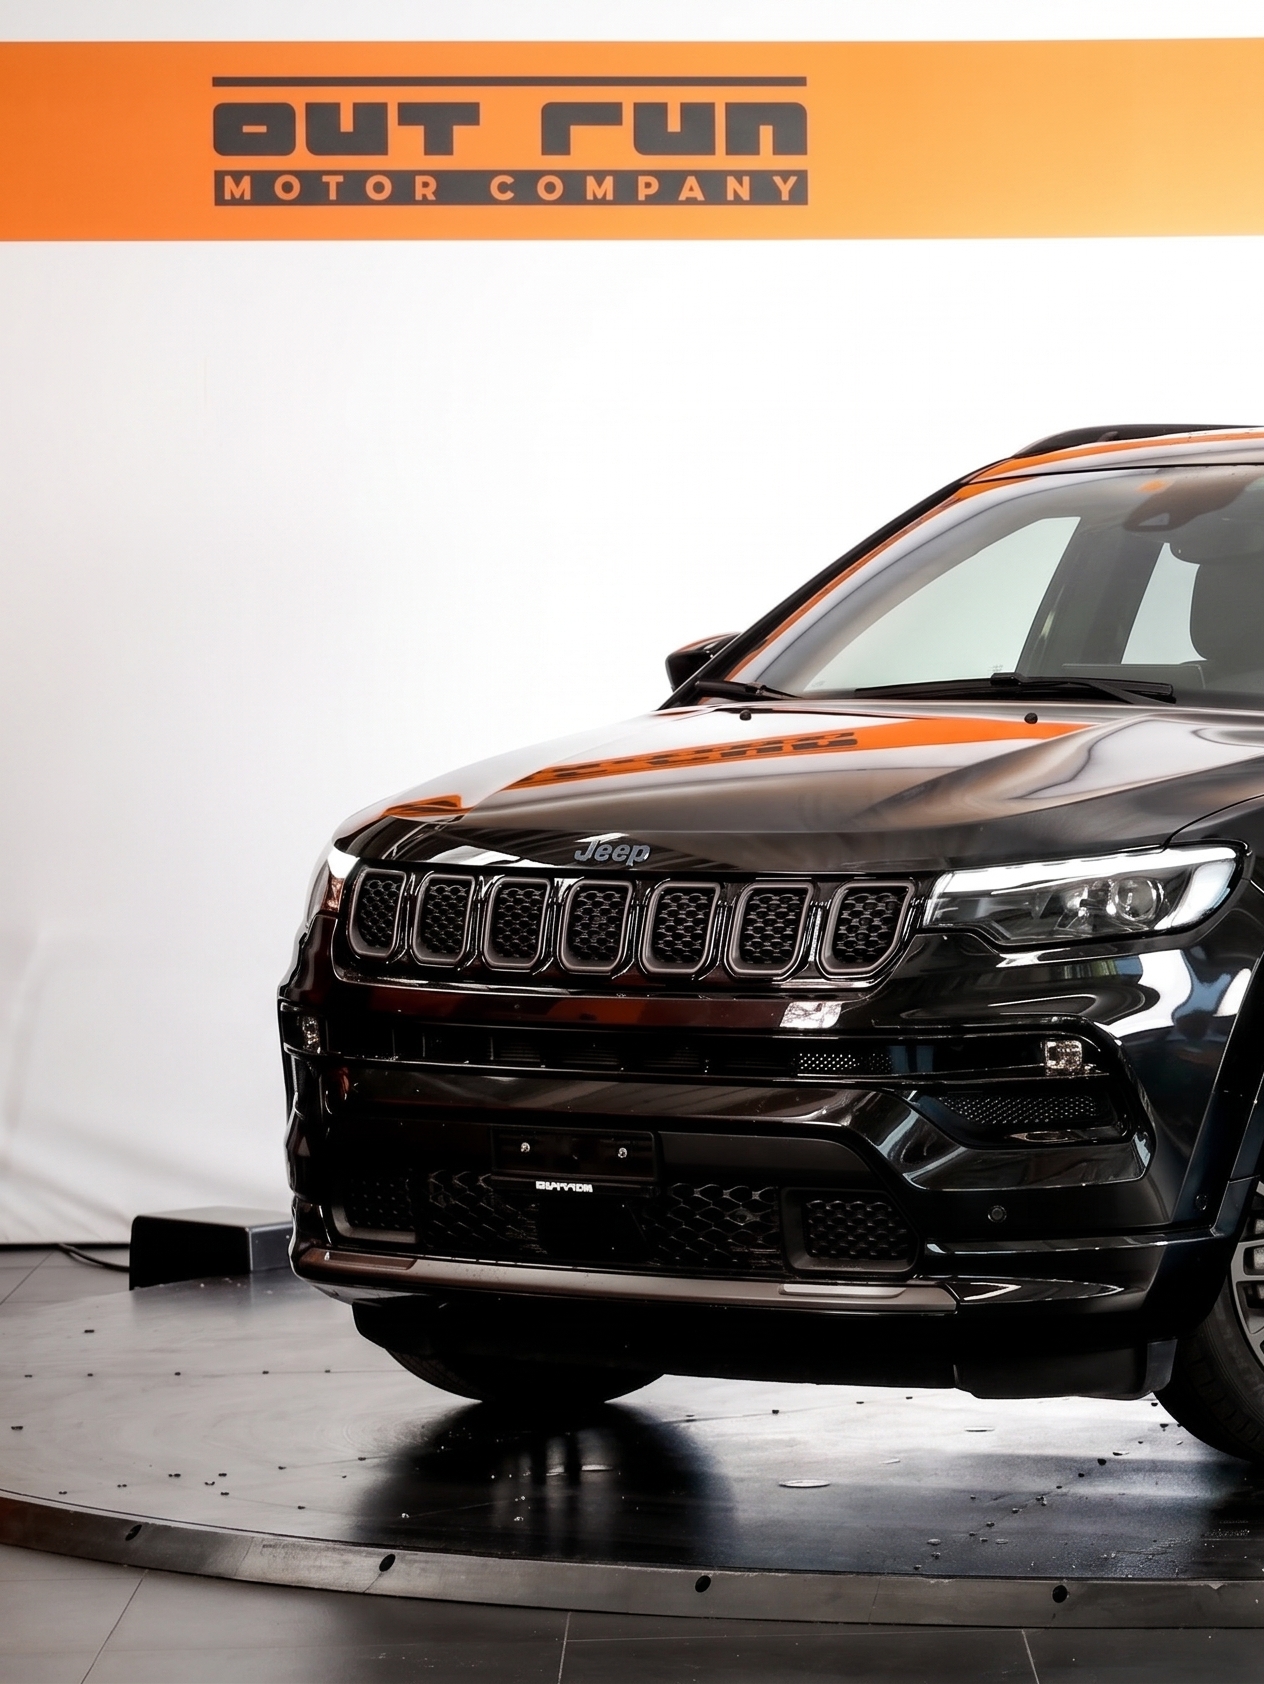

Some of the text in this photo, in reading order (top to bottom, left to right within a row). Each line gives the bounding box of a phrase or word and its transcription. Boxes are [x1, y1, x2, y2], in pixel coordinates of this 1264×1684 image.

[223, 174, 798, 202] MOTOR COMPANY
[574, 839, 651, 867] Jeep
